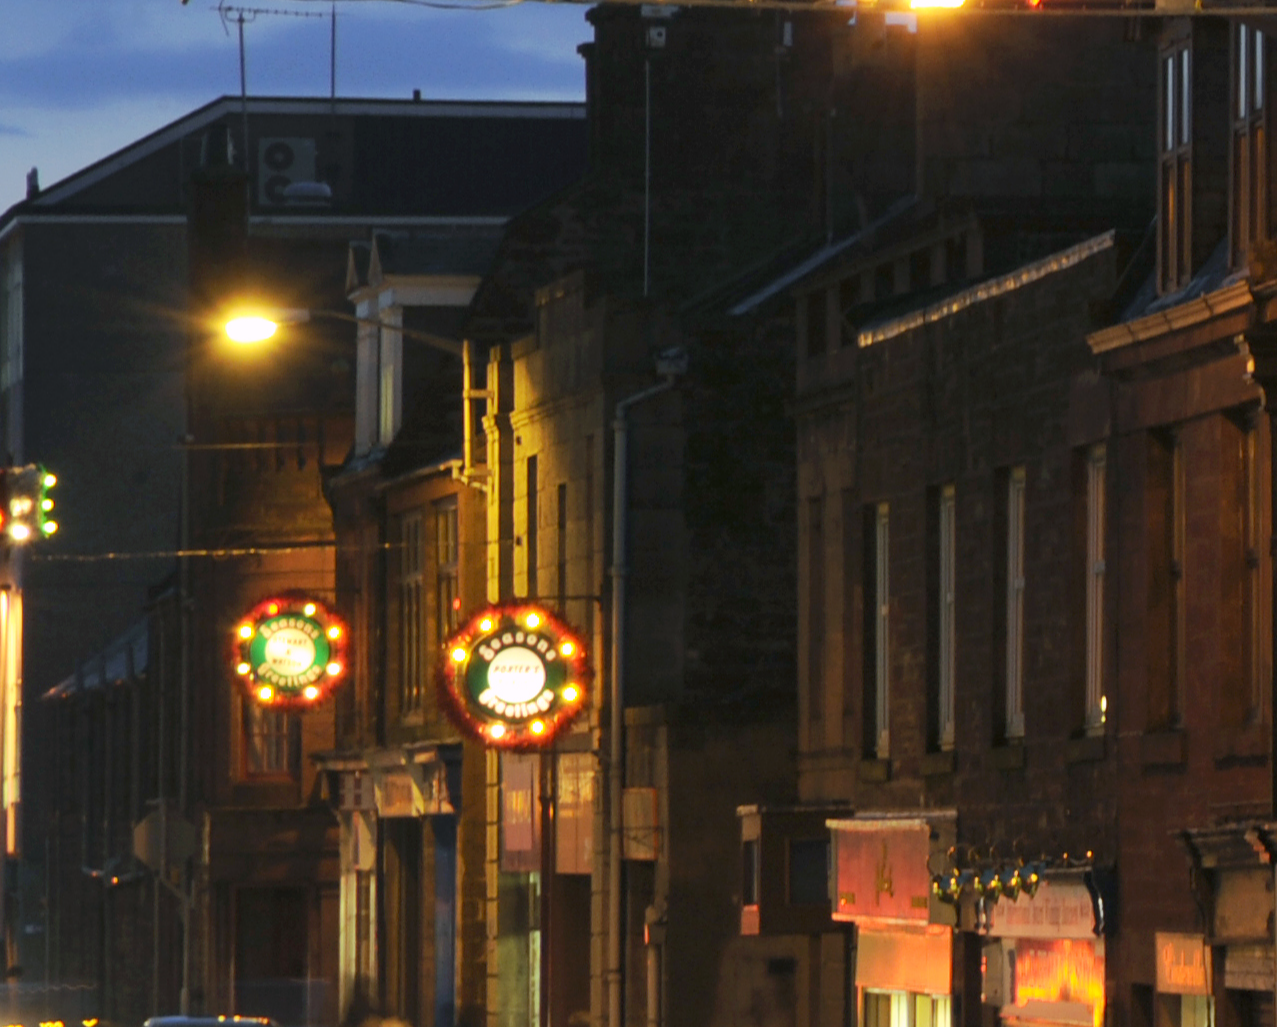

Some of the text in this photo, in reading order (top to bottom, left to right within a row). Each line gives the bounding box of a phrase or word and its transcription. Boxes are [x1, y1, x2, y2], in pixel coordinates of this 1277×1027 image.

[259, 617, 320, 640] Seasons
[478, 631, 557, 662] Seasons
[257, 662, 322, 687] Greetings
[478, 687, 555, 718] Greetings
